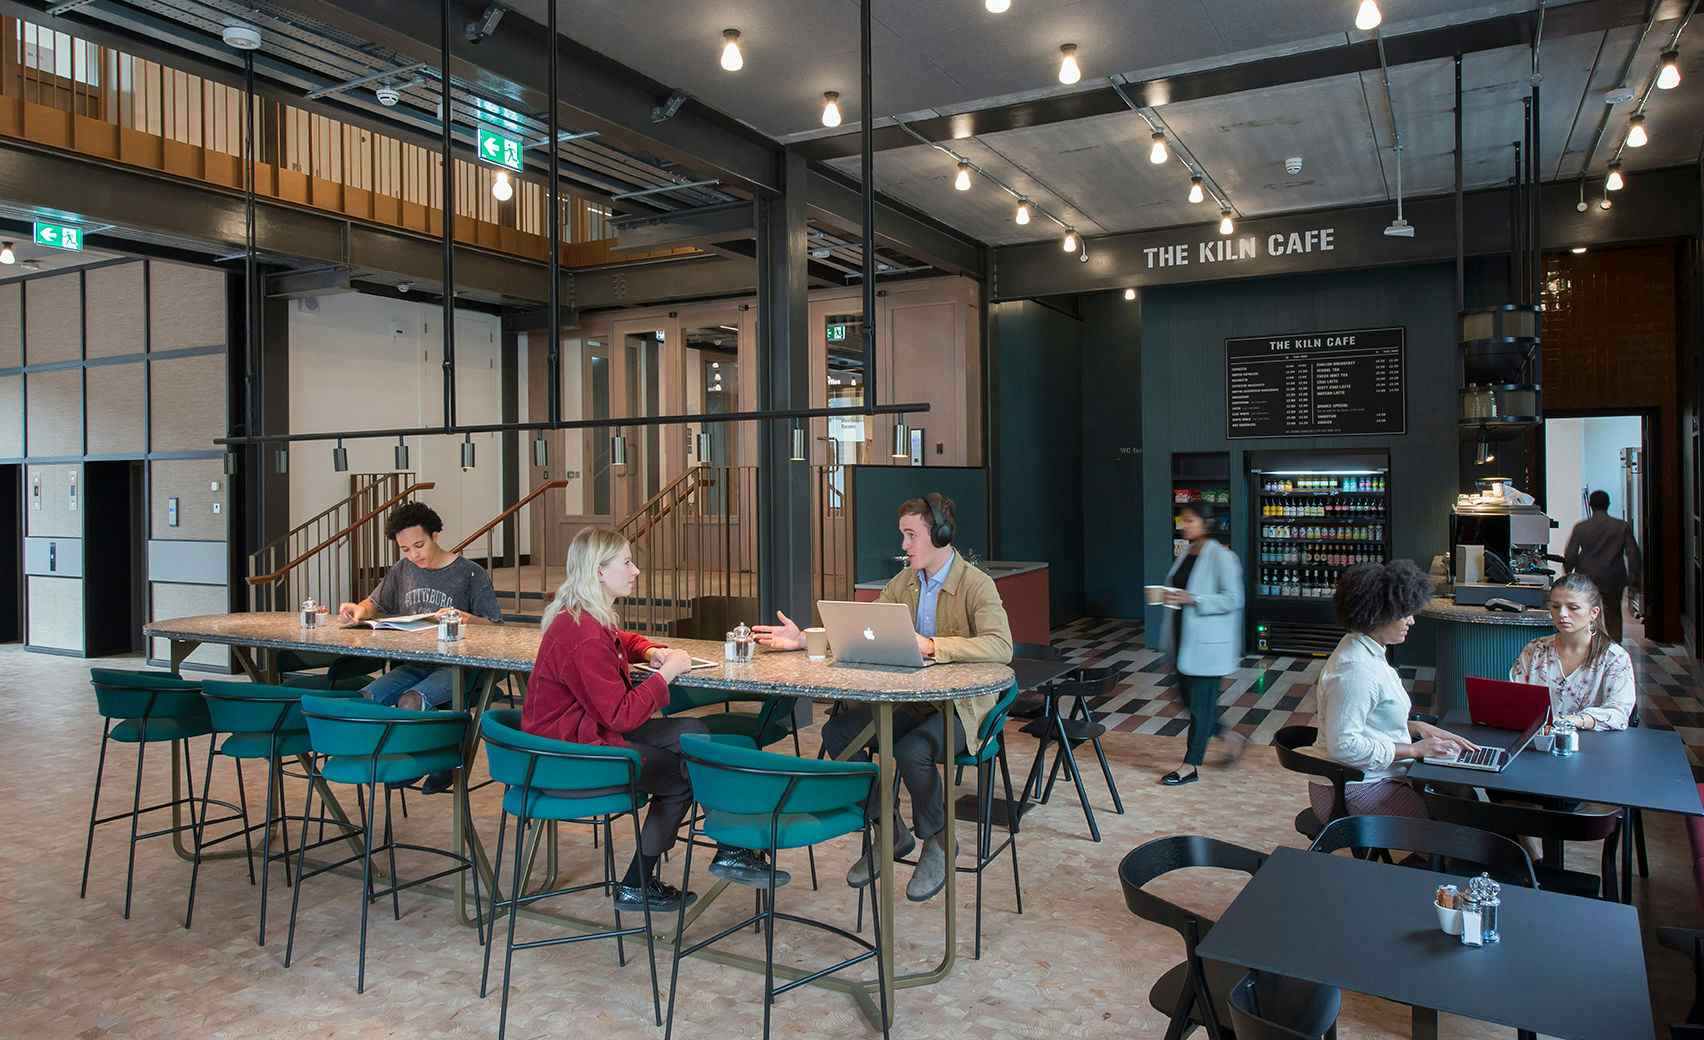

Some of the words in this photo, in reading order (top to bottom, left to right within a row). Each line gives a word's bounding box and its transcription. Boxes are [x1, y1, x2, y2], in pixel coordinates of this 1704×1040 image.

[1143, 244, 1188, 269] THE
[1199, 236, 1256, 263] KILN
[1267, 228, 1334, 256] CAFE
[1269, 340, 1290, 350] THE
[1295, 338, 1321, 349] KILN
[1326, 335, 1356, 347] CAFE
